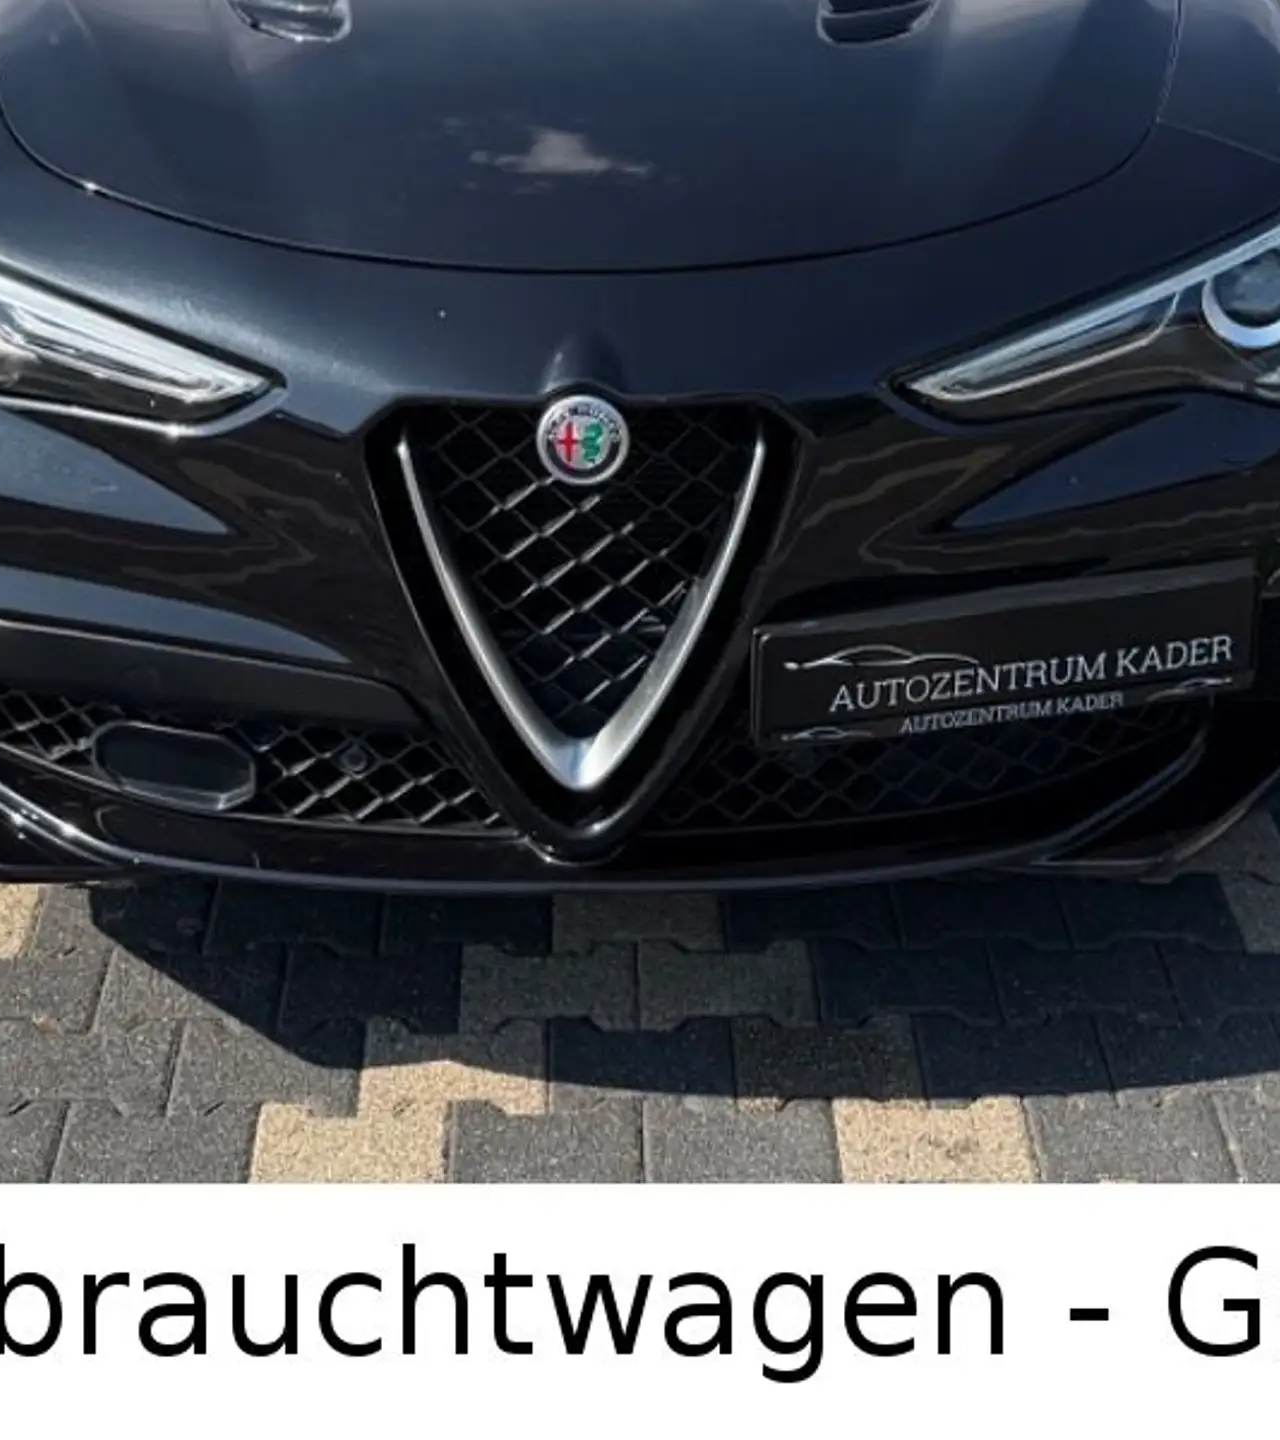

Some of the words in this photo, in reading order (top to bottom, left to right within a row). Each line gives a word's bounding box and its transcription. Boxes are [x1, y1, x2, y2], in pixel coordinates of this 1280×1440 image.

[828, 656, 1107, 713] AUTOZENTRUM
[1114, 634, 1235, 678] KADER
[899, 699, 1053, 734] AUTOZENTRUM
[1056, 691, 1126, 716] KADER
